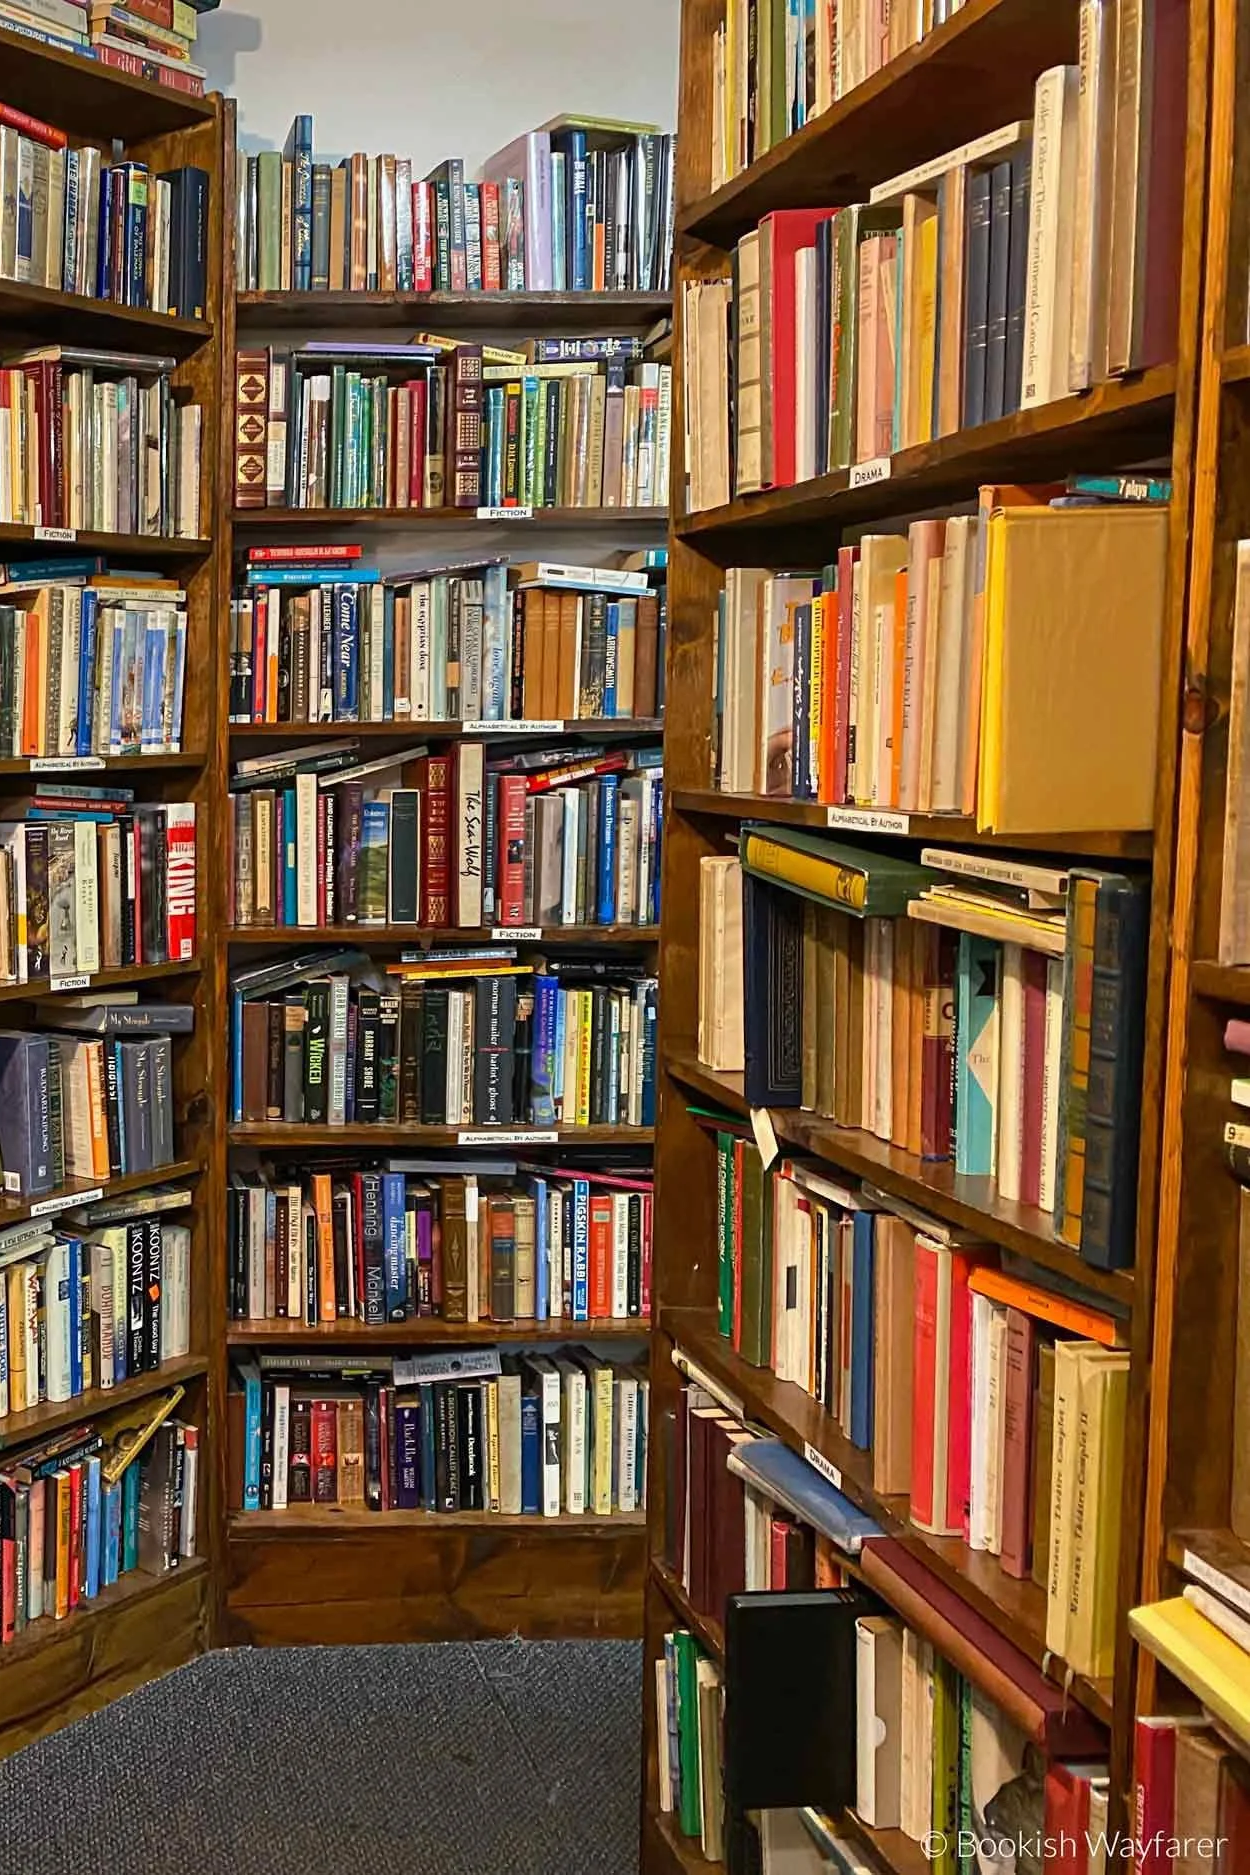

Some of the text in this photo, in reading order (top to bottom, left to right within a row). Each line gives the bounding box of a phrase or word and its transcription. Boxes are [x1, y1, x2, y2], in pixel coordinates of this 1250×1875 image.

[1035, 187, 1046, 226] Three
[1030, 230, 1045, 309] Sentimental
[1028, 312, 1040, 376] Comedies
[854, 467, 883, 483] DRAMA
[1128, 479, 1148, 498] plays
[340, 592, 356, 667] Come Near
[460, 790, 480, 877] The Sea-Wolf
[831, 813, 869, 829] ALPHABETICAL
[879, 815, 903, 831] AUTHOR
[167, 854, 194, 915] KING
[308, 1038, 326, 1084] WICKED
[363, 1030, 375, 1089] BARBARY SHORE
[488, 1087, 499, 1111] ghost
[132, 1231, 143, 1296] KOONTZ
[365, 1181, 380, 1321] Henning Mankell
[386, 1216, 399, 1255] dancing
[576, 1195, 587, 1282] PIGSKIN RABBI
[808, 1449, 836, 1479] DRAMA
[1077, 1432, 1089, 1487] Complet
[1050, 1540, 1061, 1600] Marivaux
[1070, 1557, 1081, 1617] Marivaux
